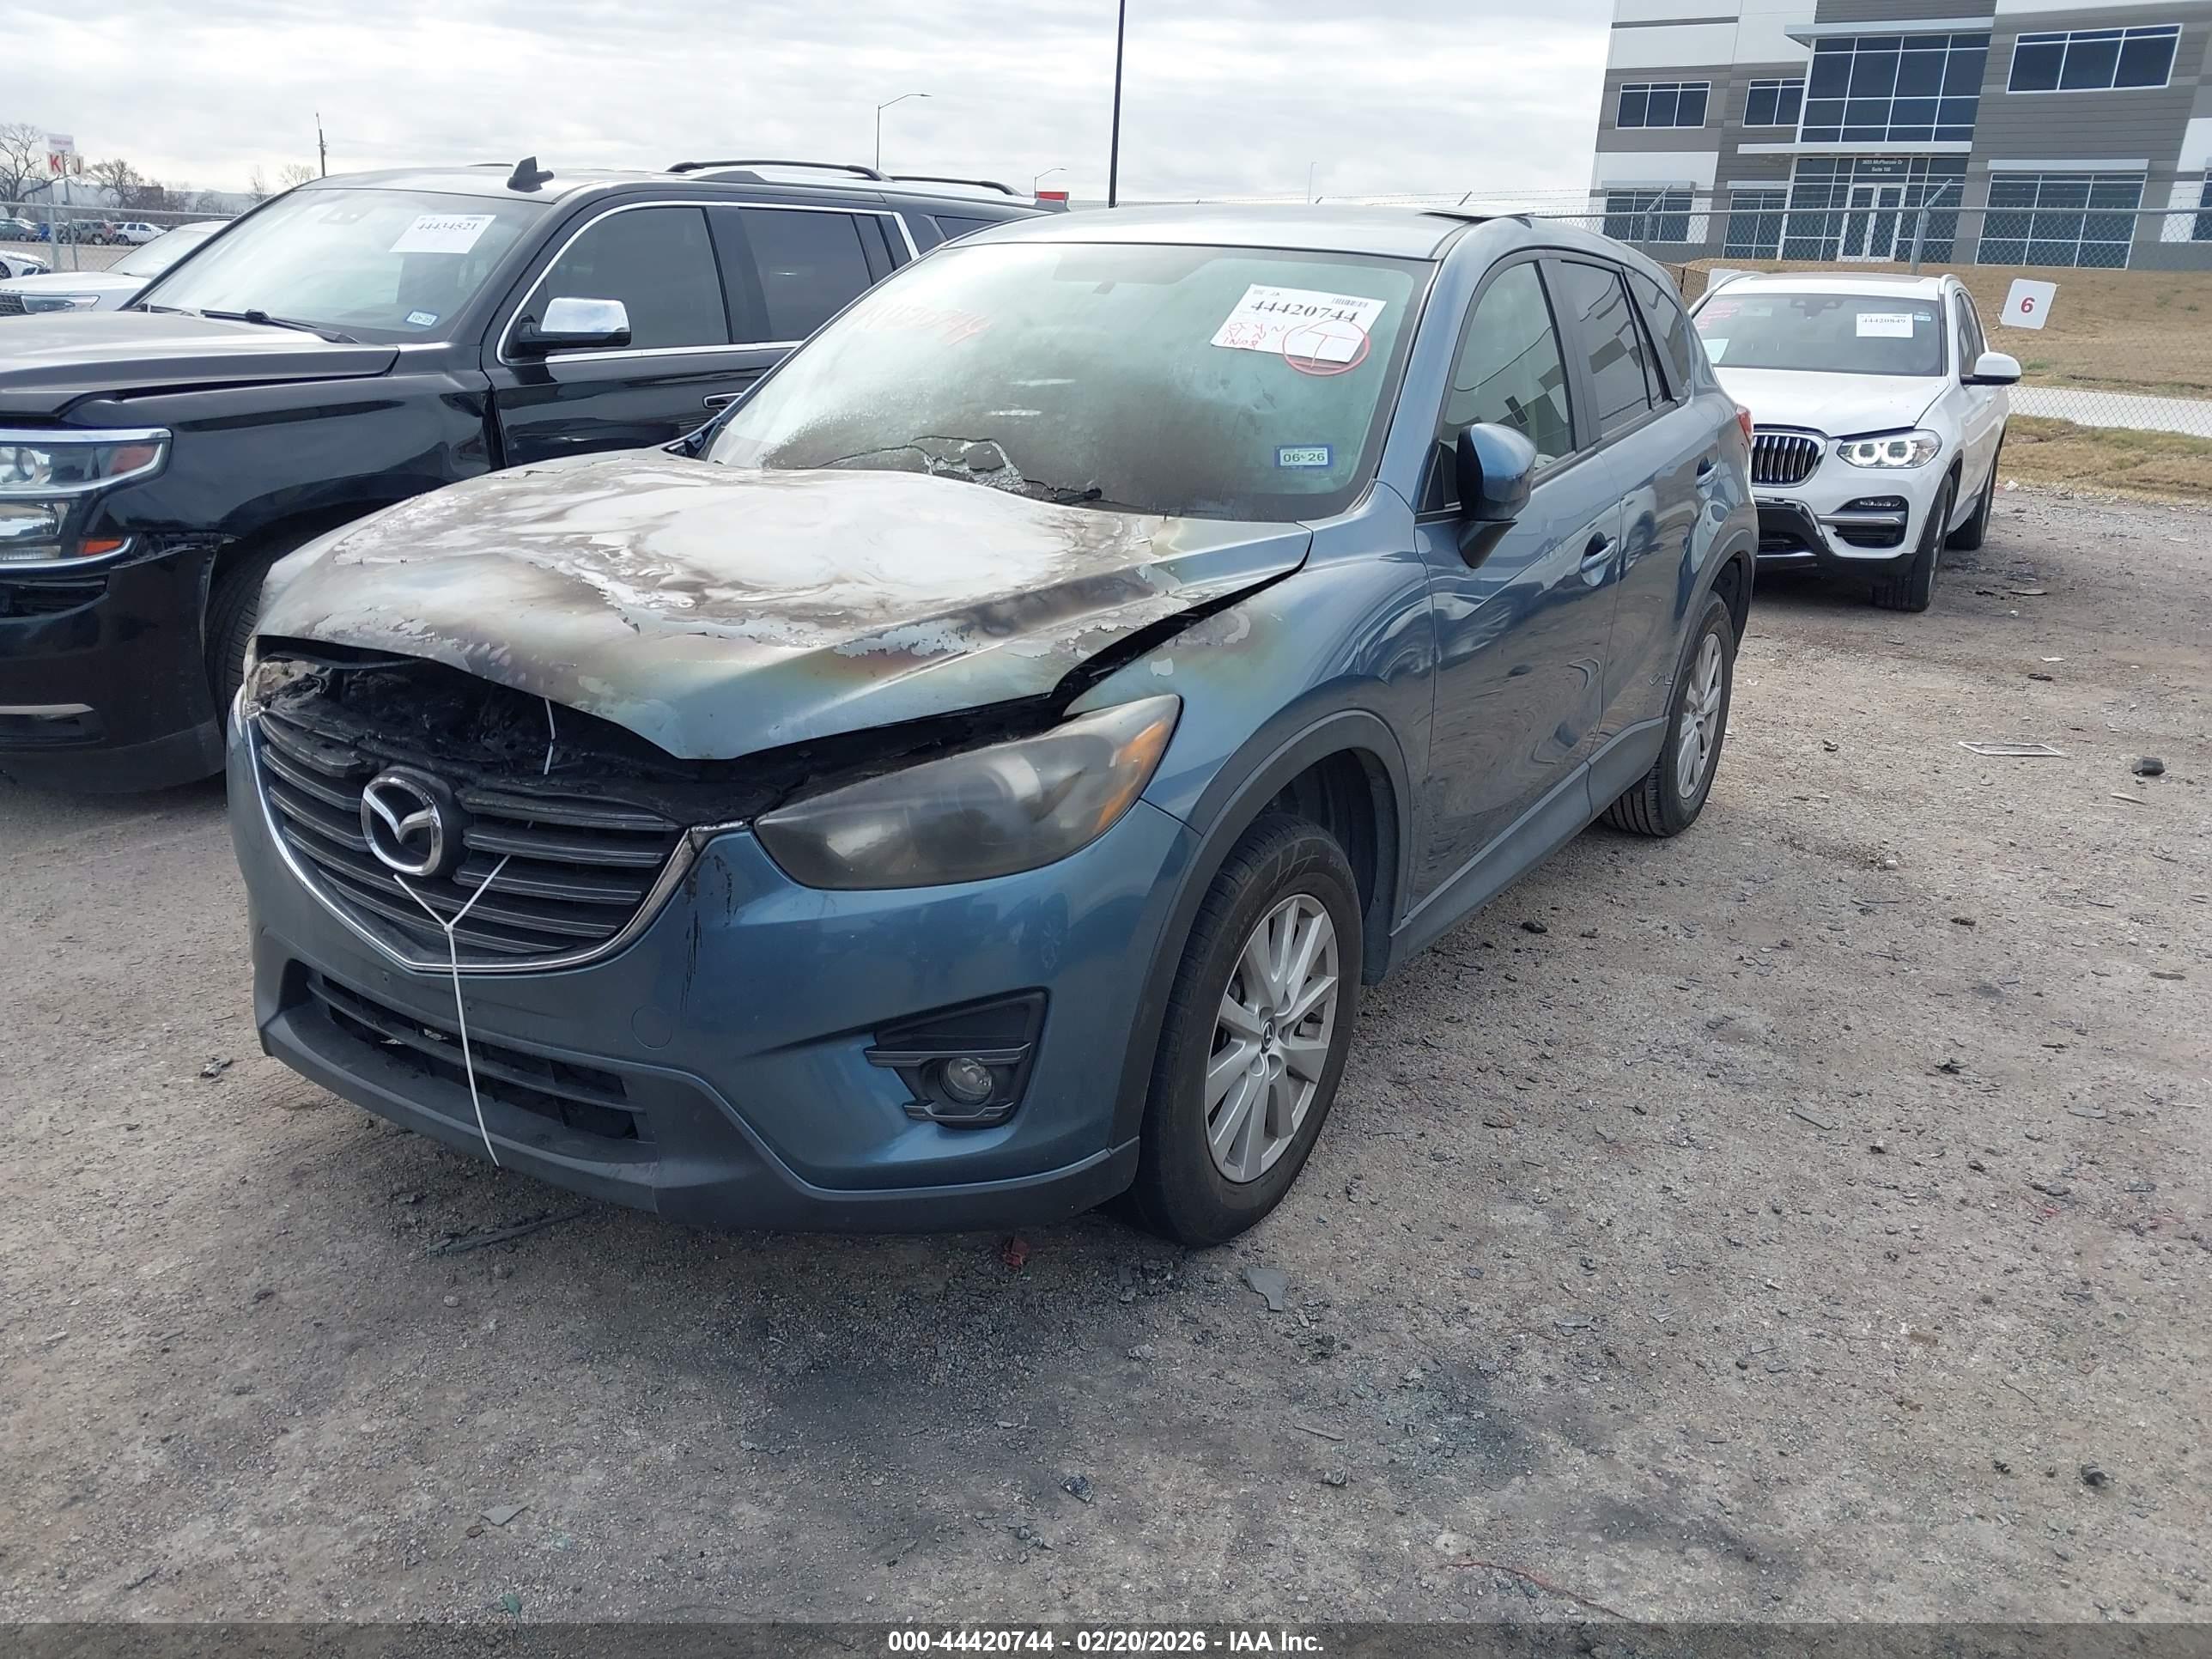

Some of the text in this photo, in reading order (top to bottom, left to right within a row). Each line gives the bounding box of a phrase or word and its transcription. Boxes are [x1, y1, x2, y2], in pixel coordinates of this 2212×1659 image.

[50, 154, 61, 173] K
[73, 157, 82, 175] J
[1250, 300, 1359, 323] 44420744
[2021, 296, 2035, 313] 6
[1283, 453, 1326, 463] 06 26
